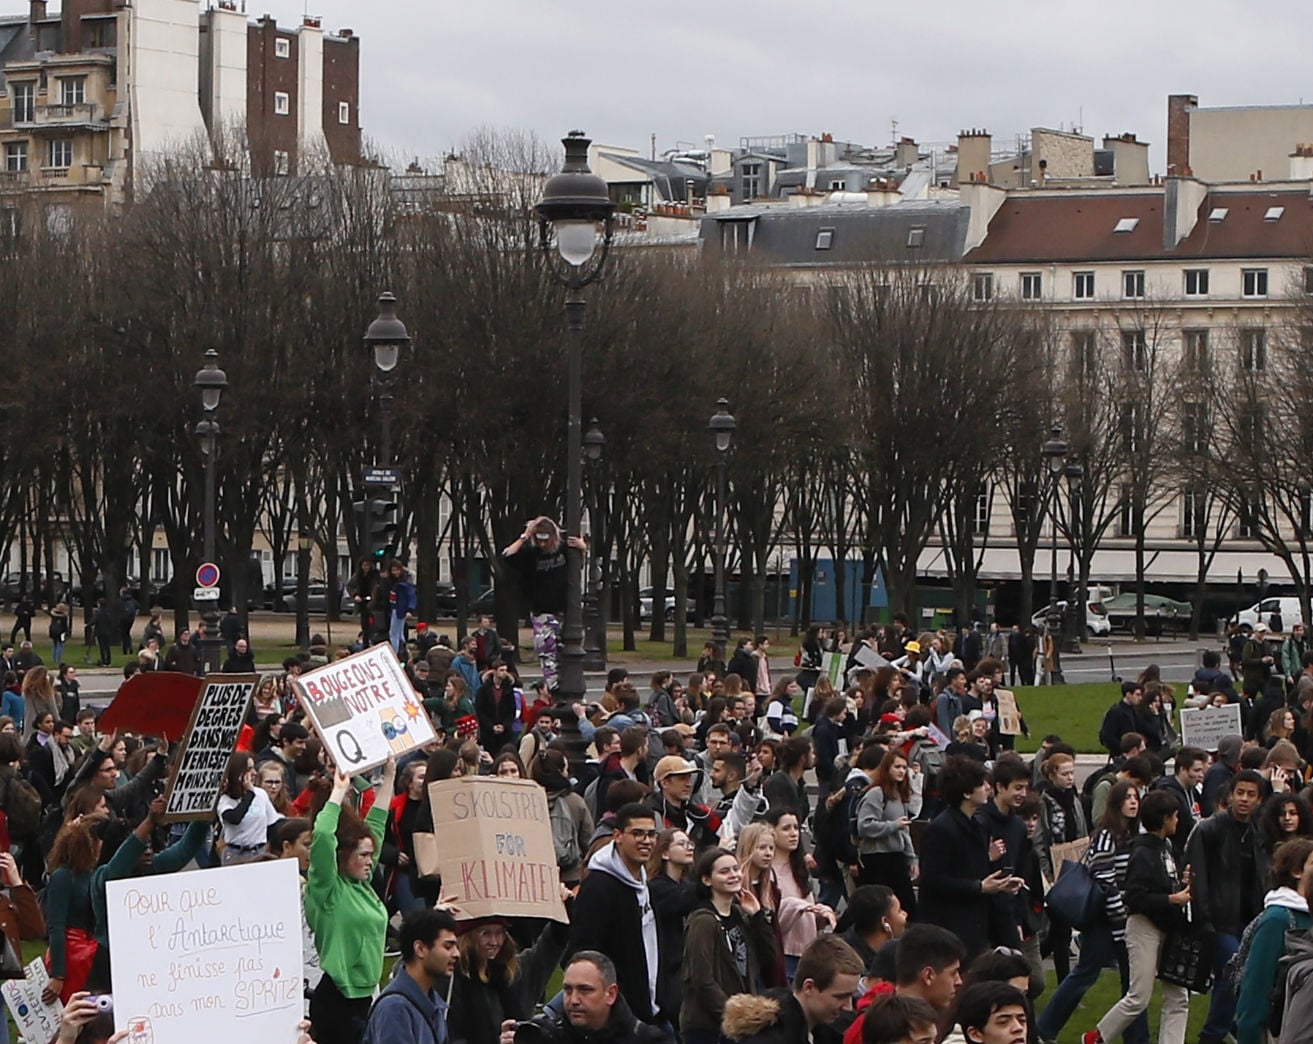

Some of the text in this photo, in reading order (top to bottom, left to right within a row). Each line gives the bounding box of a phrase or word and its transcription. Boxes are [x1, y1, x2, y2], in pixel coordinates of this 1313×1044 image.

[204, 684, 251, 706] PLUS DE
[306, 658, 384, 702] BOUGEONS
[344, 681, 395, 715] NOTRE
[196, 706, 243, 727] DEGRES
[189, 728, 222, 748] DANS
[336, 730, 367, 764] Q
[174, 771, 208, 791] MOINS
[169, 790, 217, 812] LA TERRE
[179, 888, 222, 920] que
[137, 957, 264, 992] ne finisse pas
[7, 980, 34, 1028] MONDE
[192, 994, 227, 1009] mon
[235, 976, 300, 1010] SPRITZ
[24, 987, 54, 1039] DEVIENT
